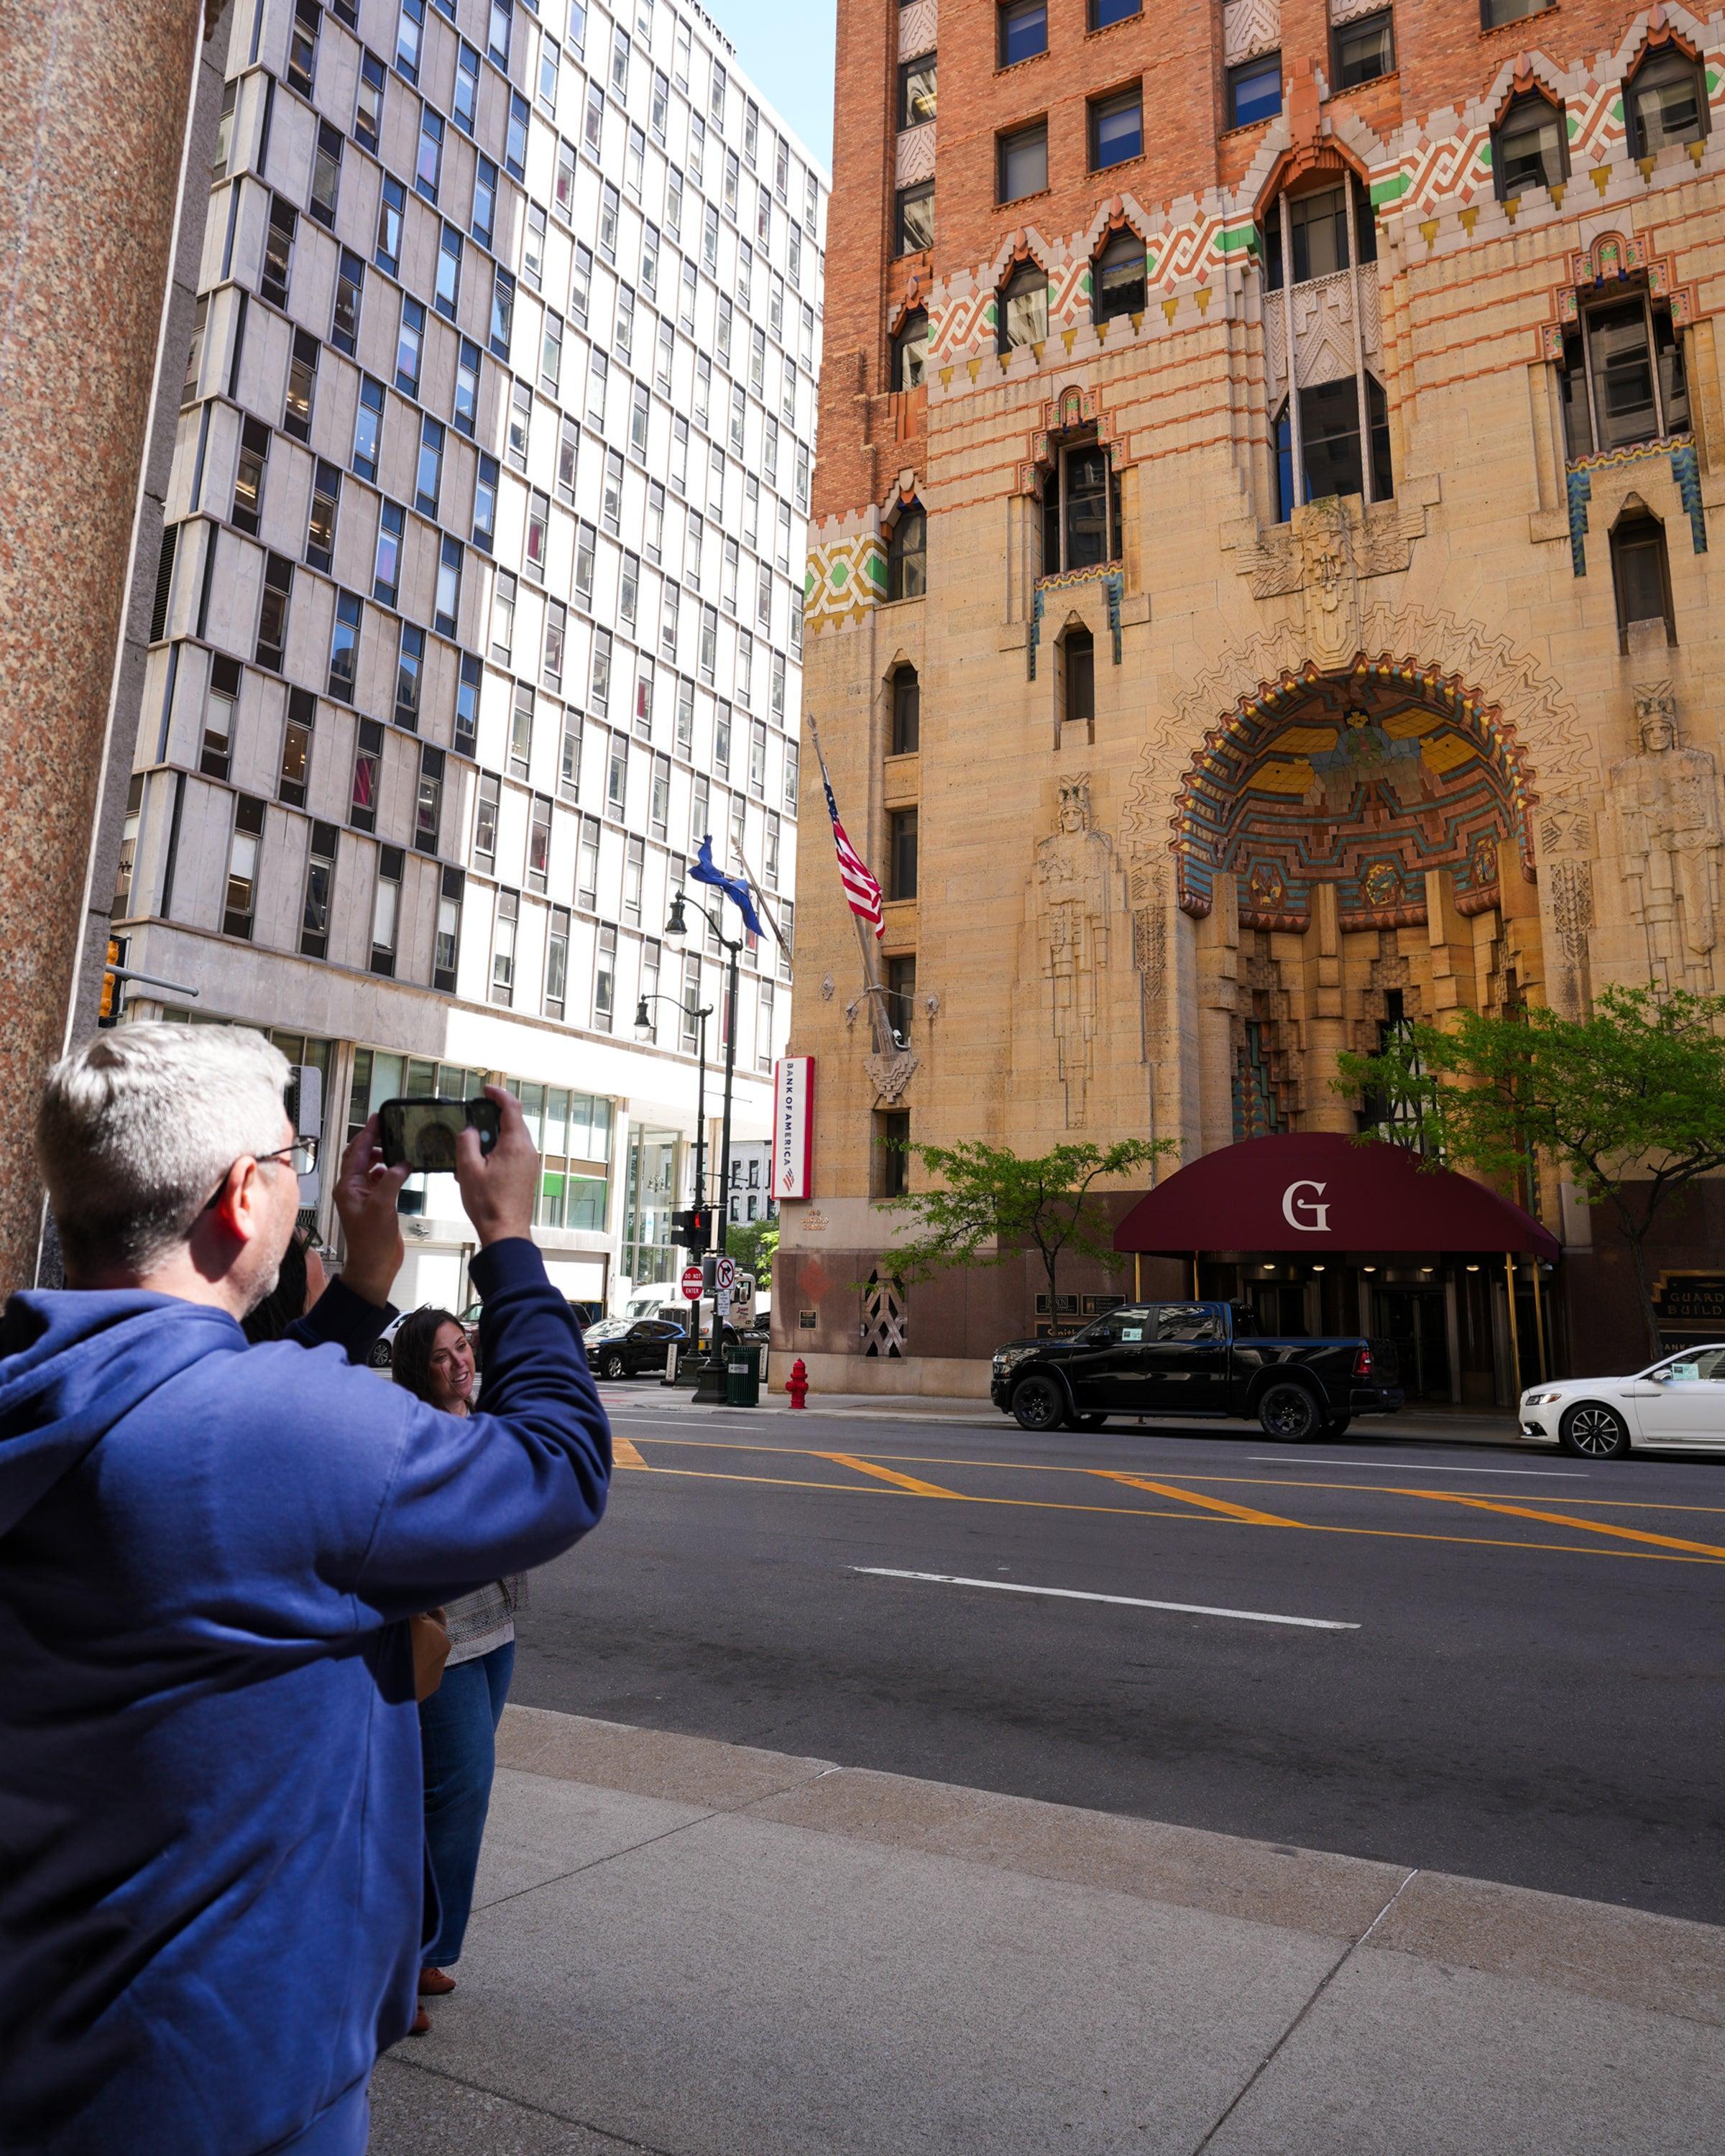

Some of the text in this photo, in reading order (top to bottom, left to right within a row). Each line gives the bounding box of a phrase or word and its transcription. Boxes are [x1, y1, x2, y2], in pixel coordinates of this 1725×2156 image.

[785, 1096, 793, 1111] OF
[783, 1113, 792, 1166] AMERICA
[1282, 1180, 1332, 1231] G
